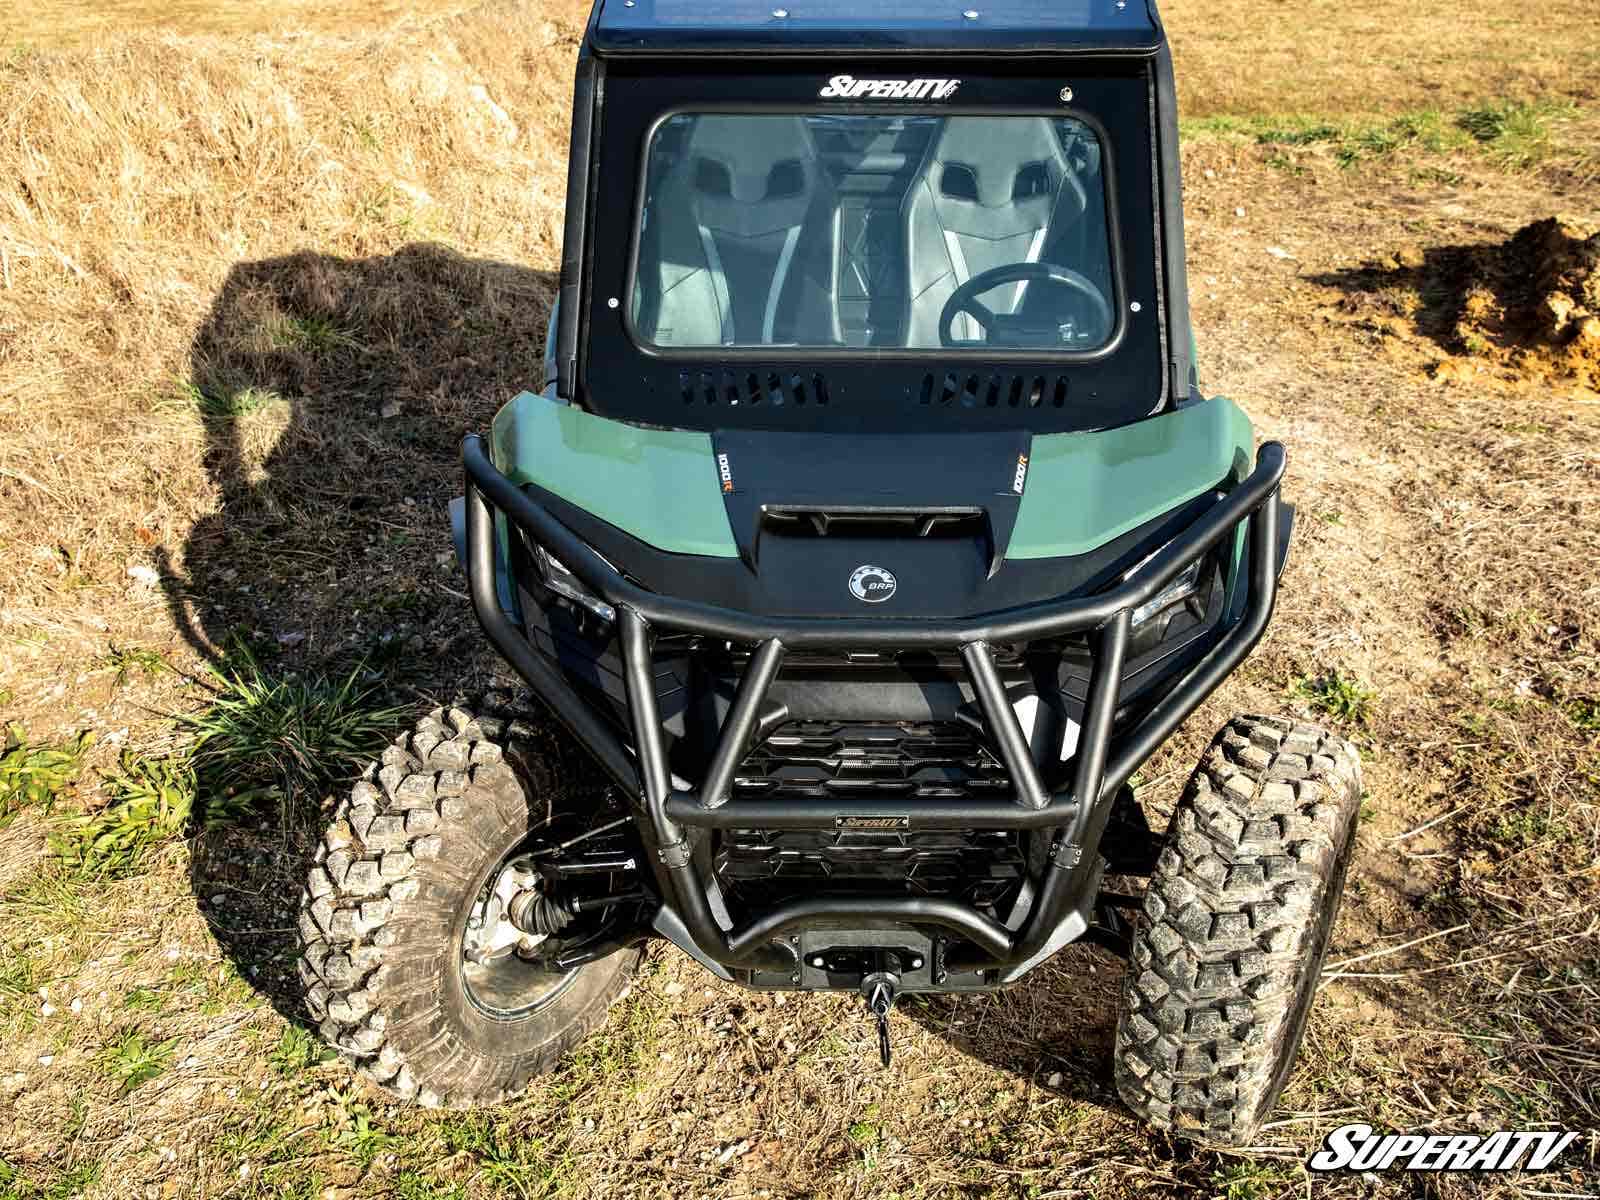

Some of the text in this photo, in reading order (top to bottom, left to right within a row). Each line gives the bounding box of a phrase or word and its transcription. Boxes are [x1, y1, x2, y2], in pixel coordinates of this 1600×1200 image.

[820, 75, 961, 98] SUPERATV
[718, 454, 733, 491] 1000R
[1013, 455, 1028, 494] 1000R
[868, 582, 894, 590] BRP
